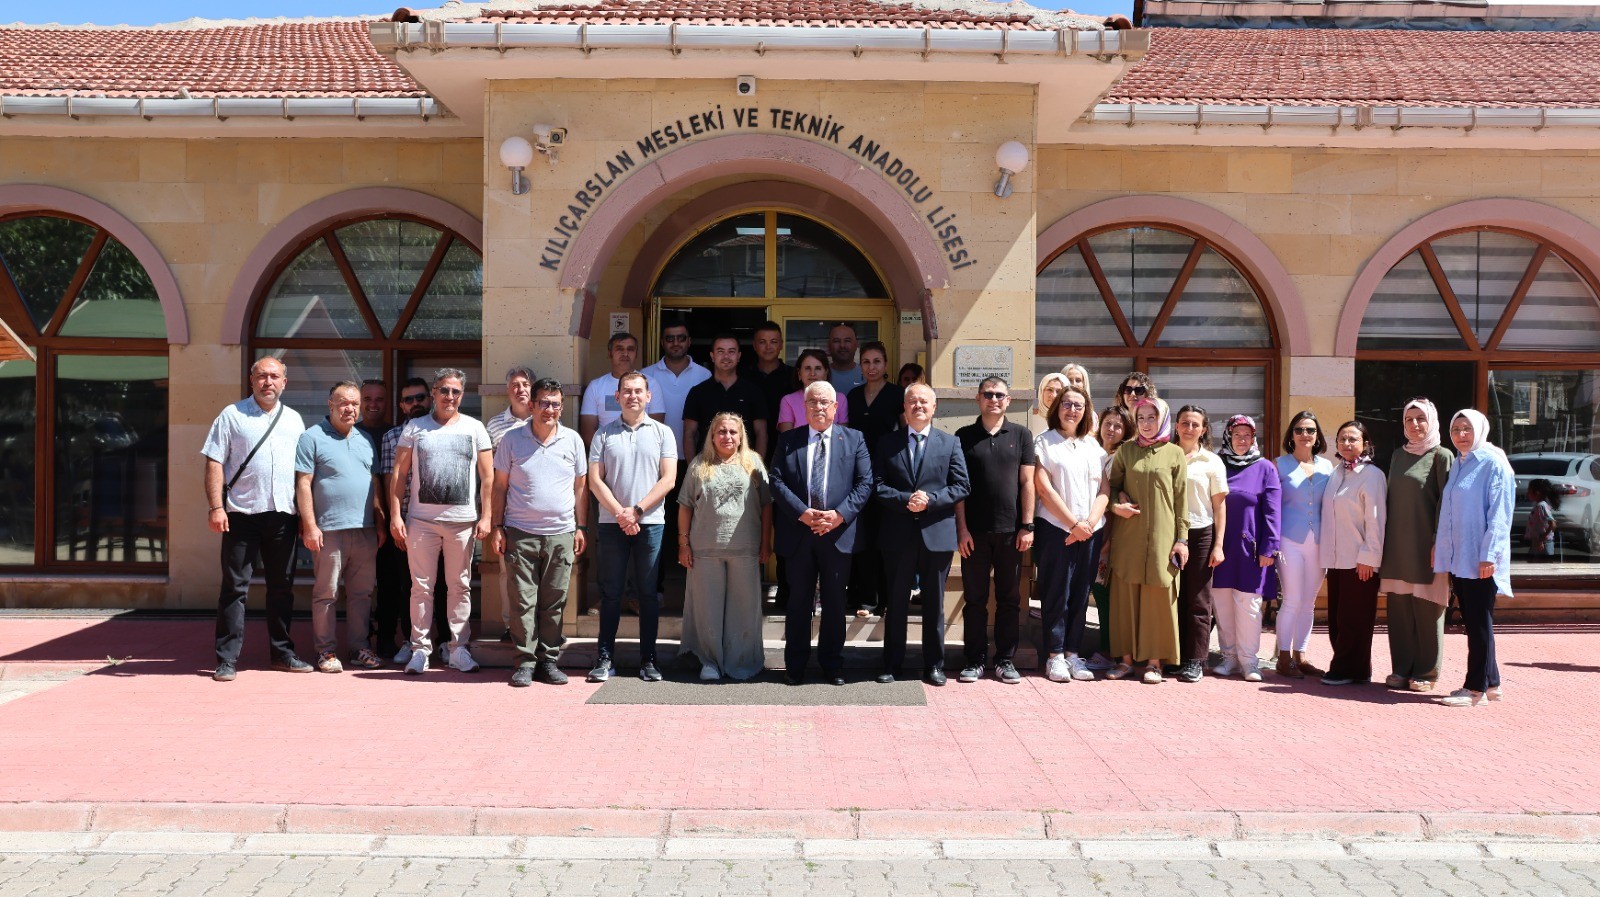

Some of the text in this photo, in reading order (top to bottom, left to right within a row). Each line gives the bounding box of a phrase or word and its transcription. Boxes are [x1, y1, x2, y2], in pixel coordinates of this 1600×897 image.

[539, 105, 977, 271] KILIÇARSLAN MESLEKİ VE TEKNİK ANADOLU LİSESİ
